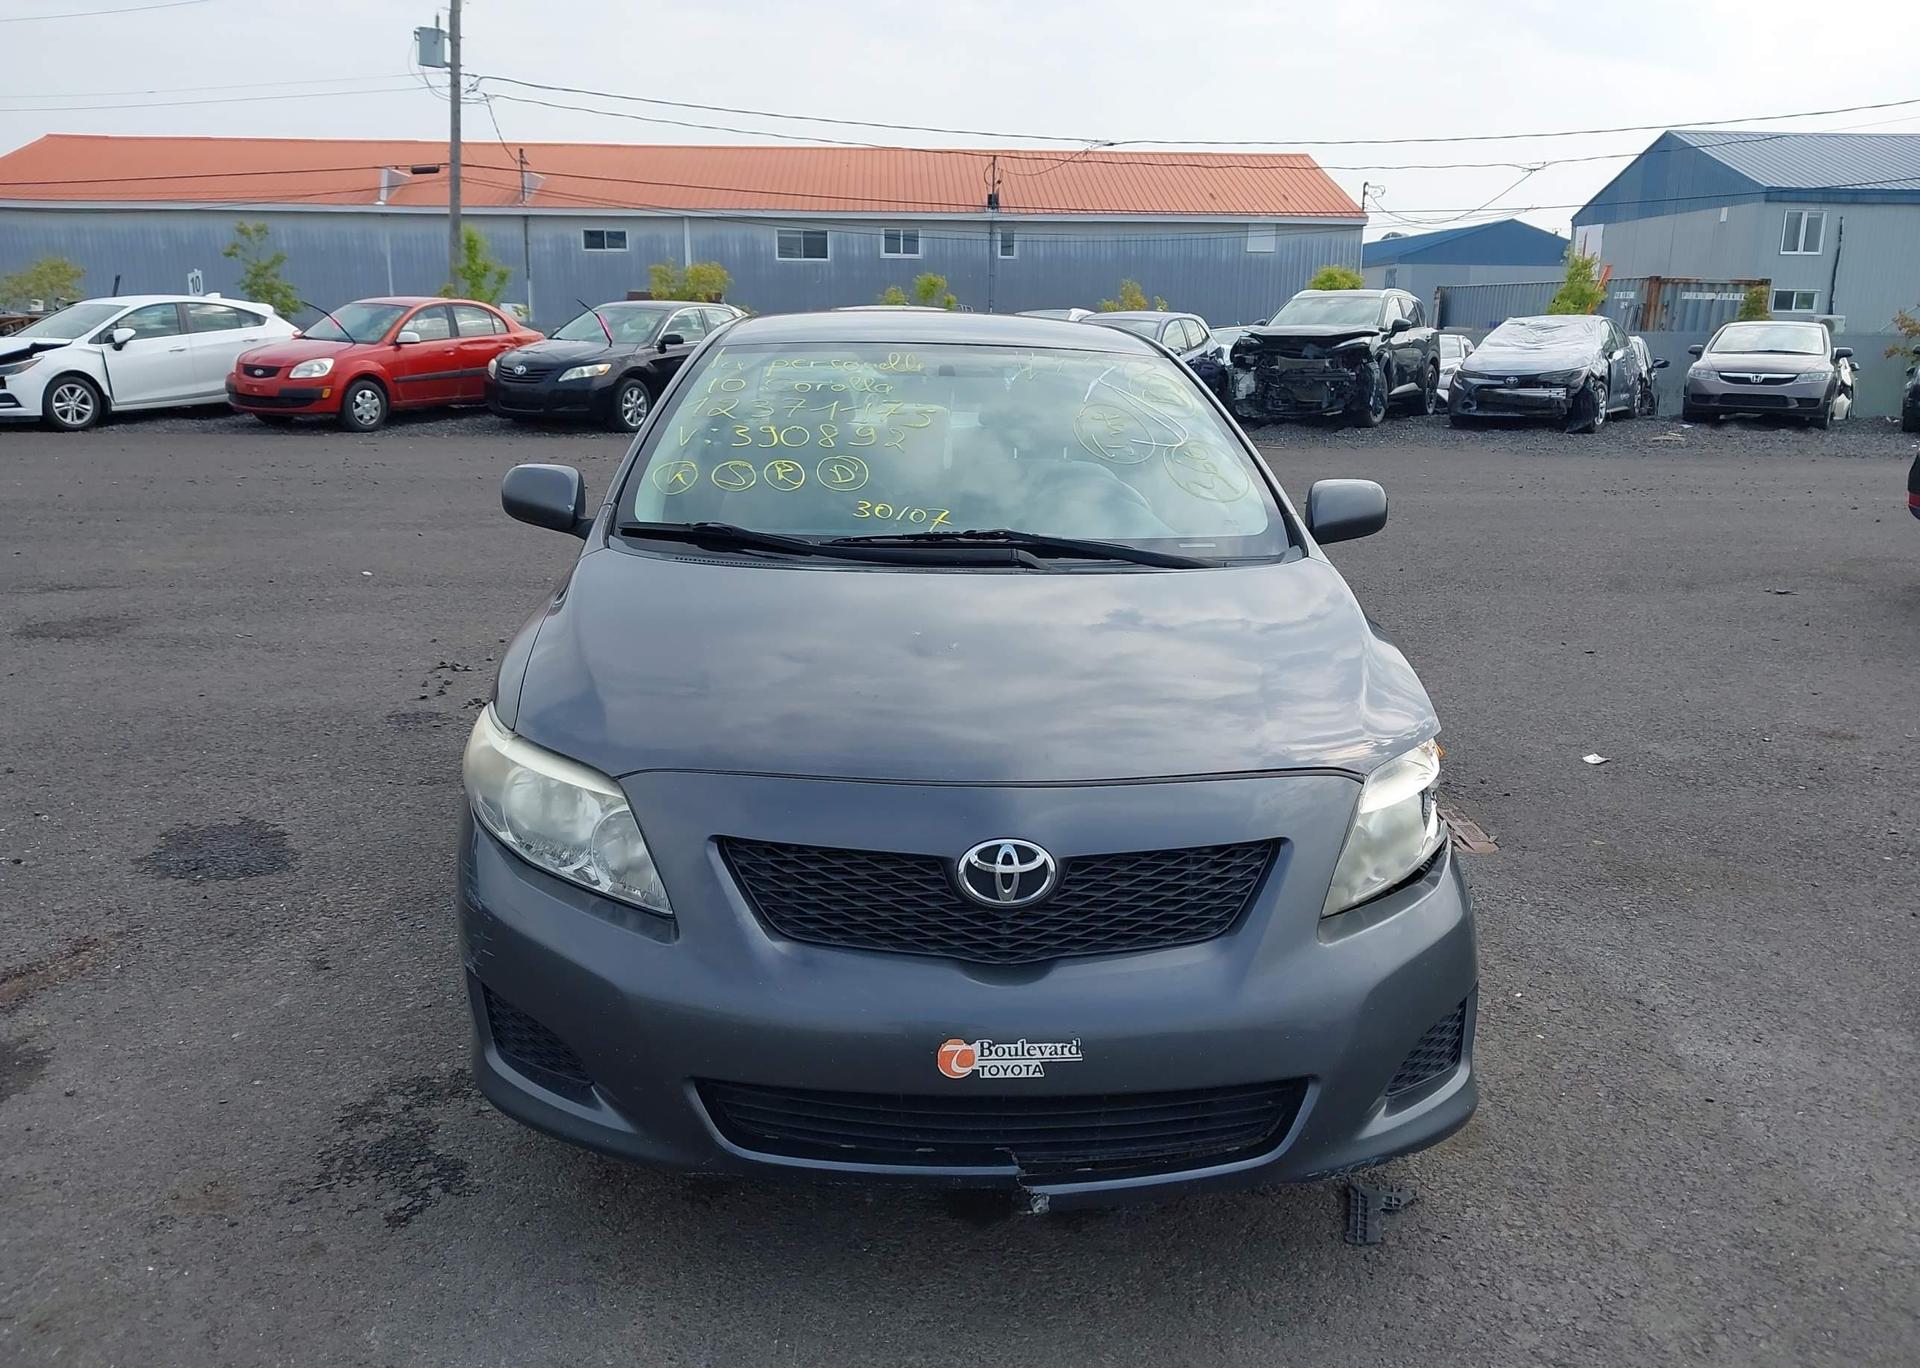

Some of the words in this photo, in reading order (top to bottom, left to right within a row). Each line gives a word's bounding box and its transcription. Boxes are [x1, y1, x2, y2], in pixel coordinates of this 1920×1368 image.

[190, 275, 201, 294] 10
[707, 377, 746, 394] 10
[852, 500, 952, 534] 30/07
[978, 1038, 1082, 1058] Boulevard
[979, 1063, 1044, 1077] TOYOTA
